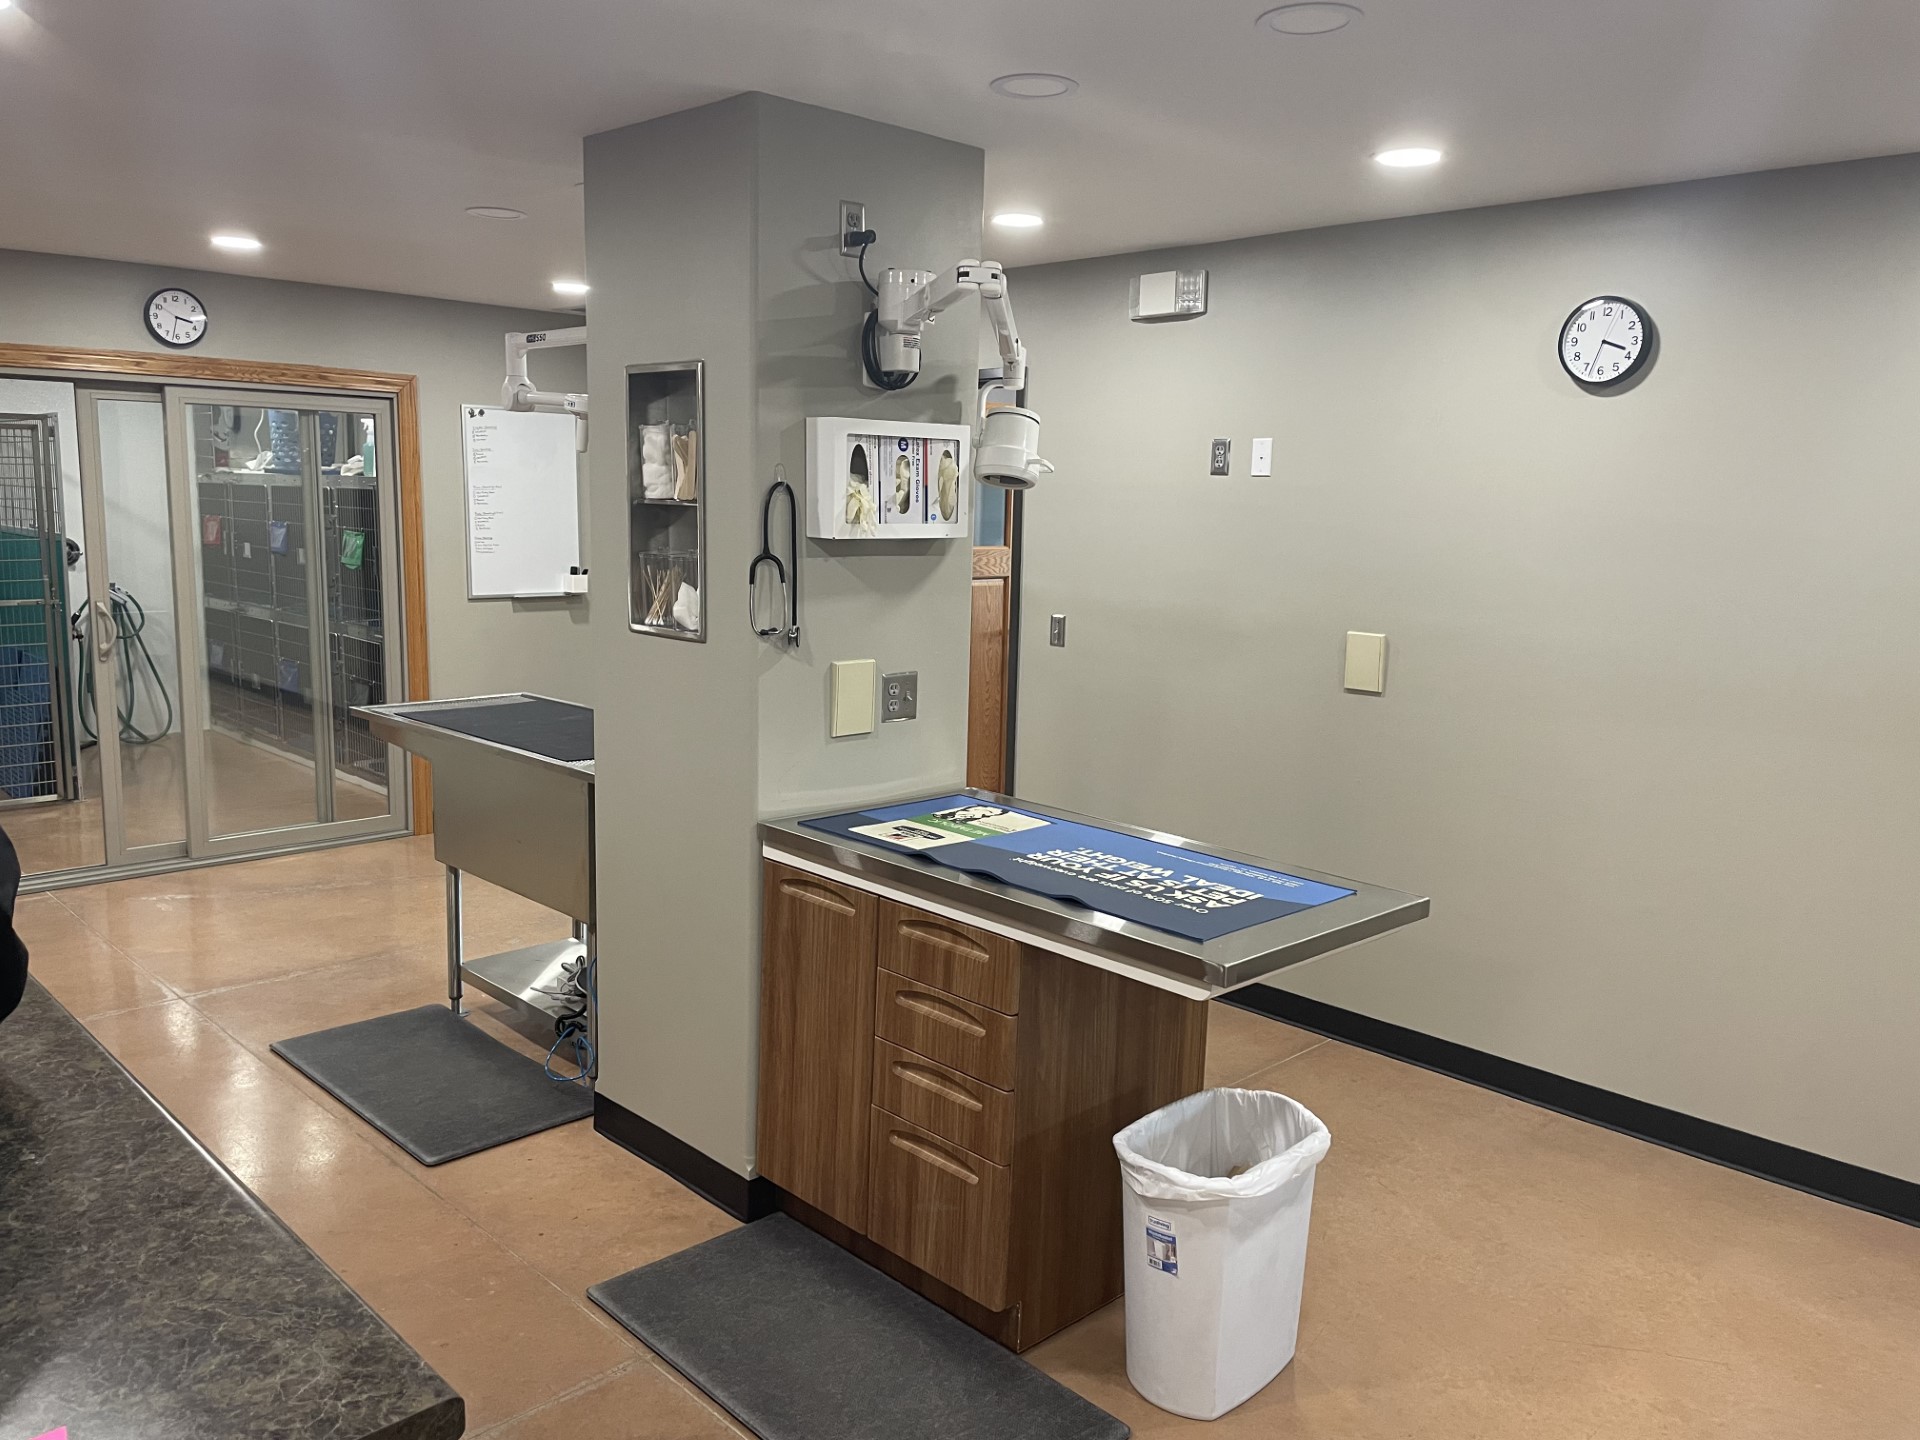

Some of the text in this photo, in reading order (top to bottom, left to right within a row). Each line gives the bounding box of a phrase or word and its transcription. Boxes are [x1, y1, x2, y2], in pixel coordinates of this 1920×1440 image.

[1590, 311, 1595, 320] 11
[1603, 307, 1613, 317] 12
[1577, 323, 1586, 332] 10
[1628, 321, 1636, 330] 2
[1571, 337, 1578, 346] 9
[1631, 336, 1639, 345] 3
[1573, 352, 1581, 361] 8
[1624, 351, 1631, 360] 4
[1584, 363, 1590, 371] 7
[1597, 366, 1604, 375] 6
[1612, 362, 1620, 372] 5
[1072, 847, 1175, 877] WEIGHT.
[1026, 852, 1232, 908] ASK US IF YOUR
[1046, 849, 1247, 905] PET IS AT THEIR
[1098, 881, 1129, 890] pets
[1182, 874, 1264, 900] IDEAL
[1143, 893, 1174, 904] 50%
[1174, 903, 1208, 913] Over
